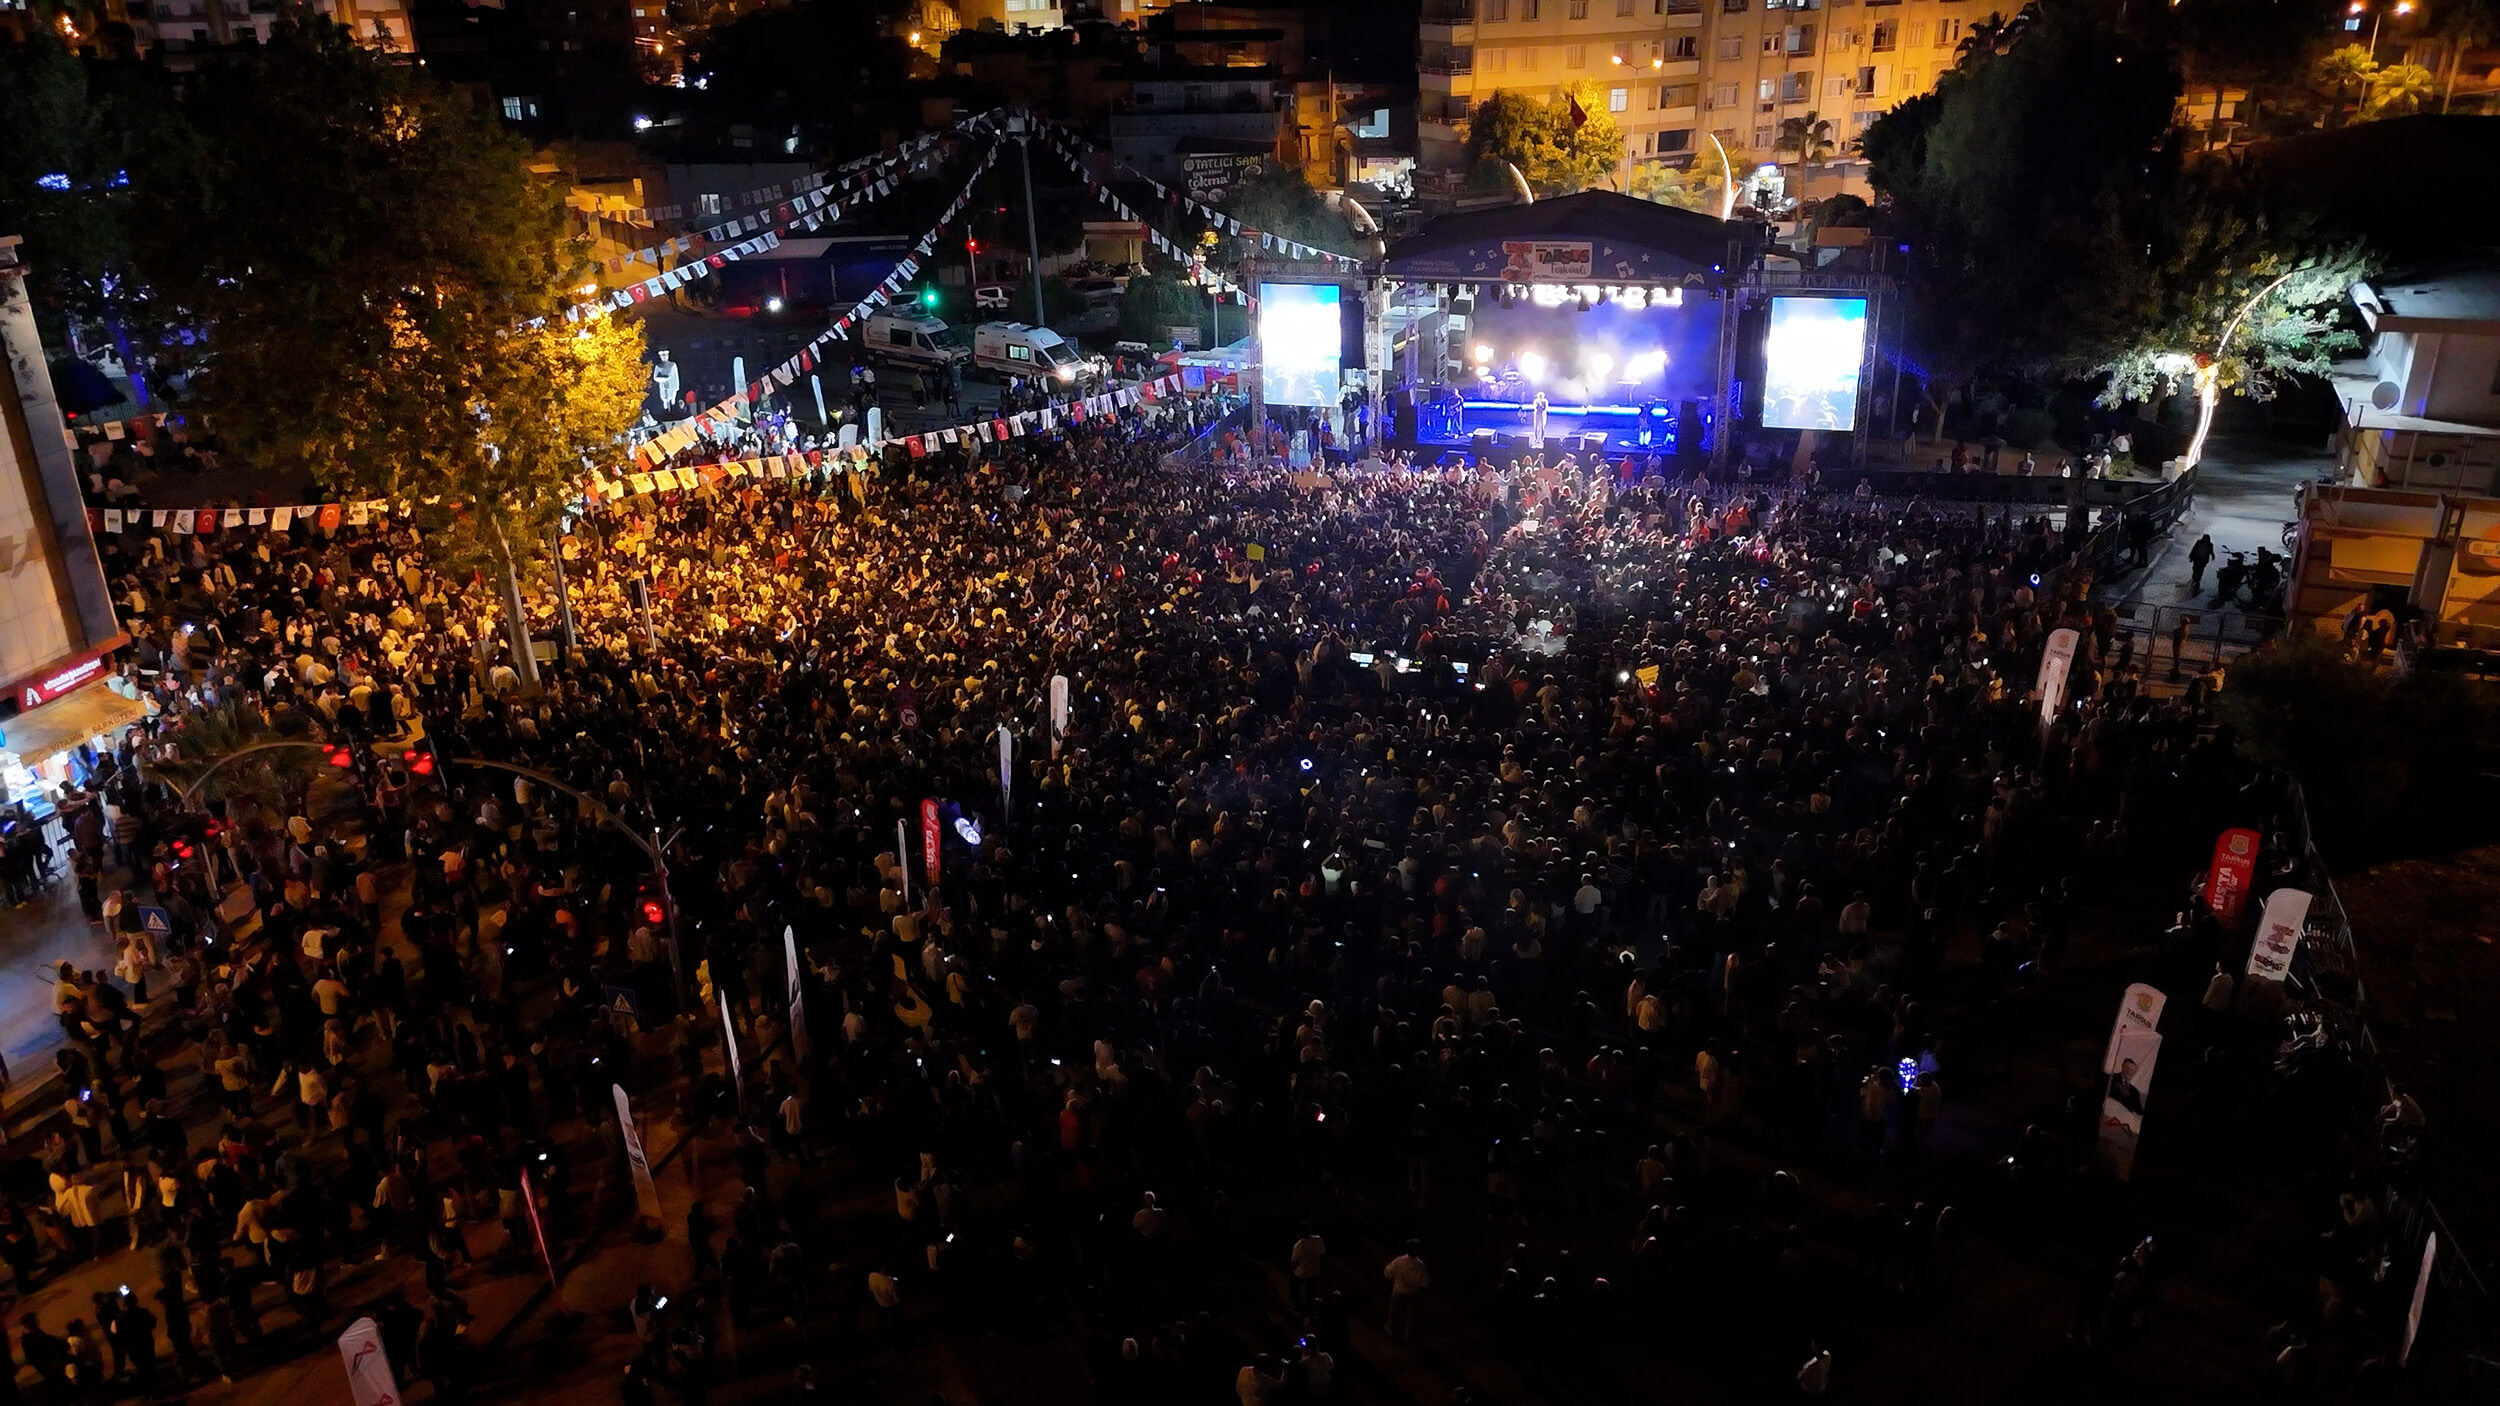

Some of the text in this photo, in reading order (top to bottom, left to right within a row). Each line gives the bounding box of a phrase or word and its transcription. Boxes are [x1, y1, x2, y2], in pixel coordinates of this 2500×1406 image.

[1195, 157, 1233, 169] TATLICI
[1535, 248, 1590, 265] TARSUS
[2127, 1007, 2152, 1028] TARSUS
